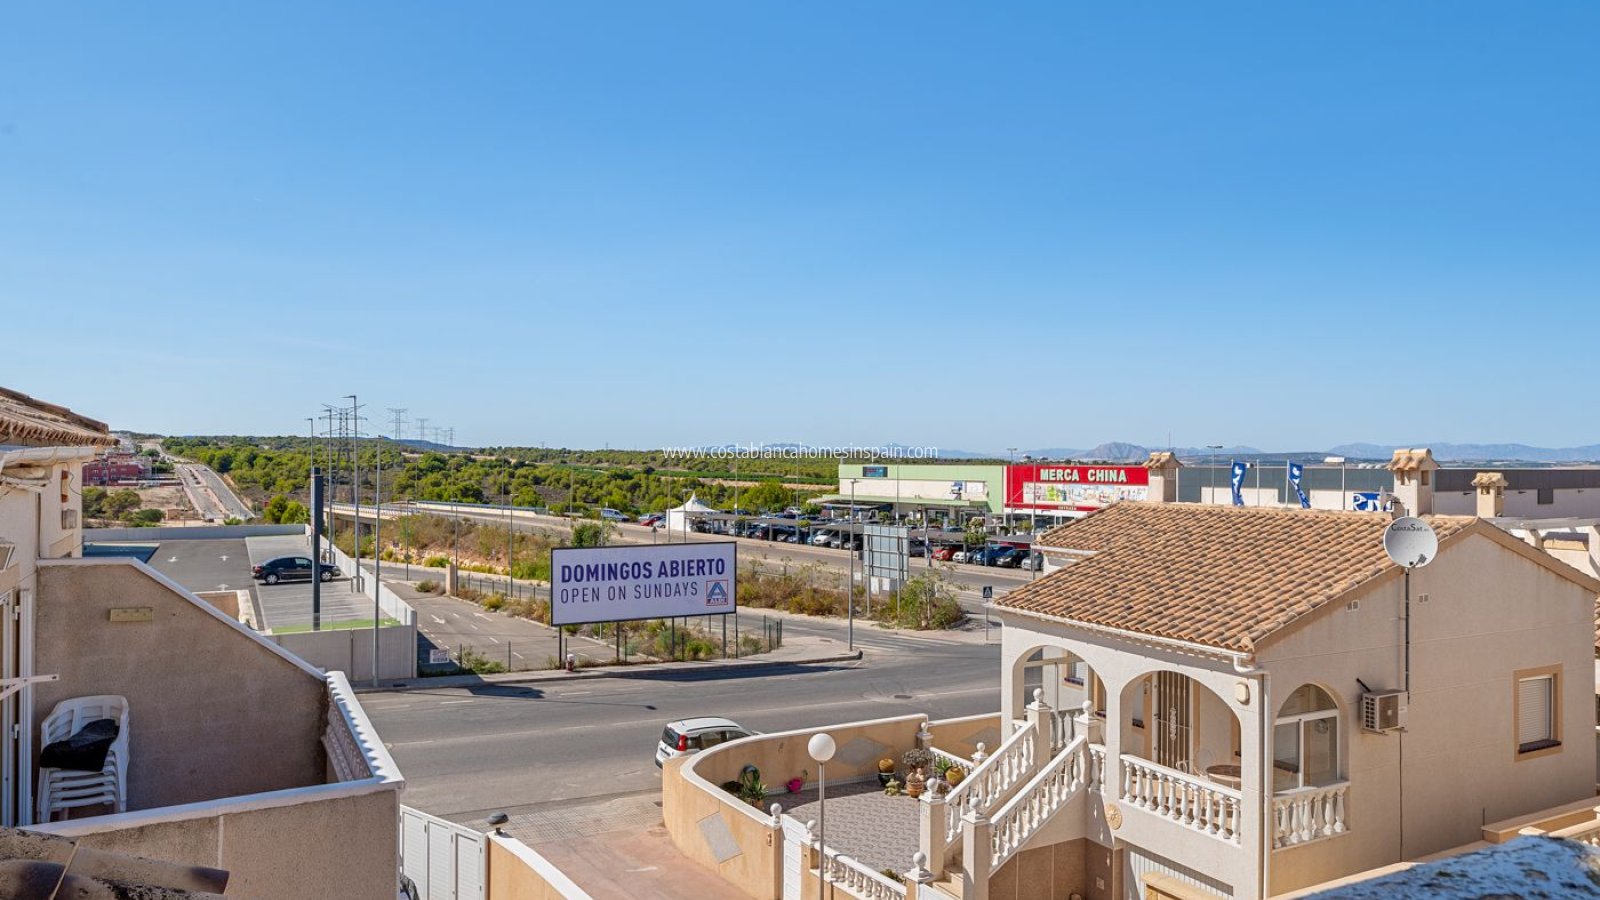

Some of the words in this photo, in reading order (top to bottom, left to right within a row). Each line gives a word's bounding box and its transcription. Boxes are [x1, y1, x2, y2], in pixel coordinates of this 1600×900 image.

[1040, 468, 1080, 481] MERCA
[1087, 469, 1127, 482] CHINA
[561, 561, 653, 583] DOMINGOS
[657, 558, 725, 578] ABIERTO
[560, 587, 600, 604] OPEN
[608, 585, 626, 600] ON
[634, 581, 698, 599] SUNDAYS
